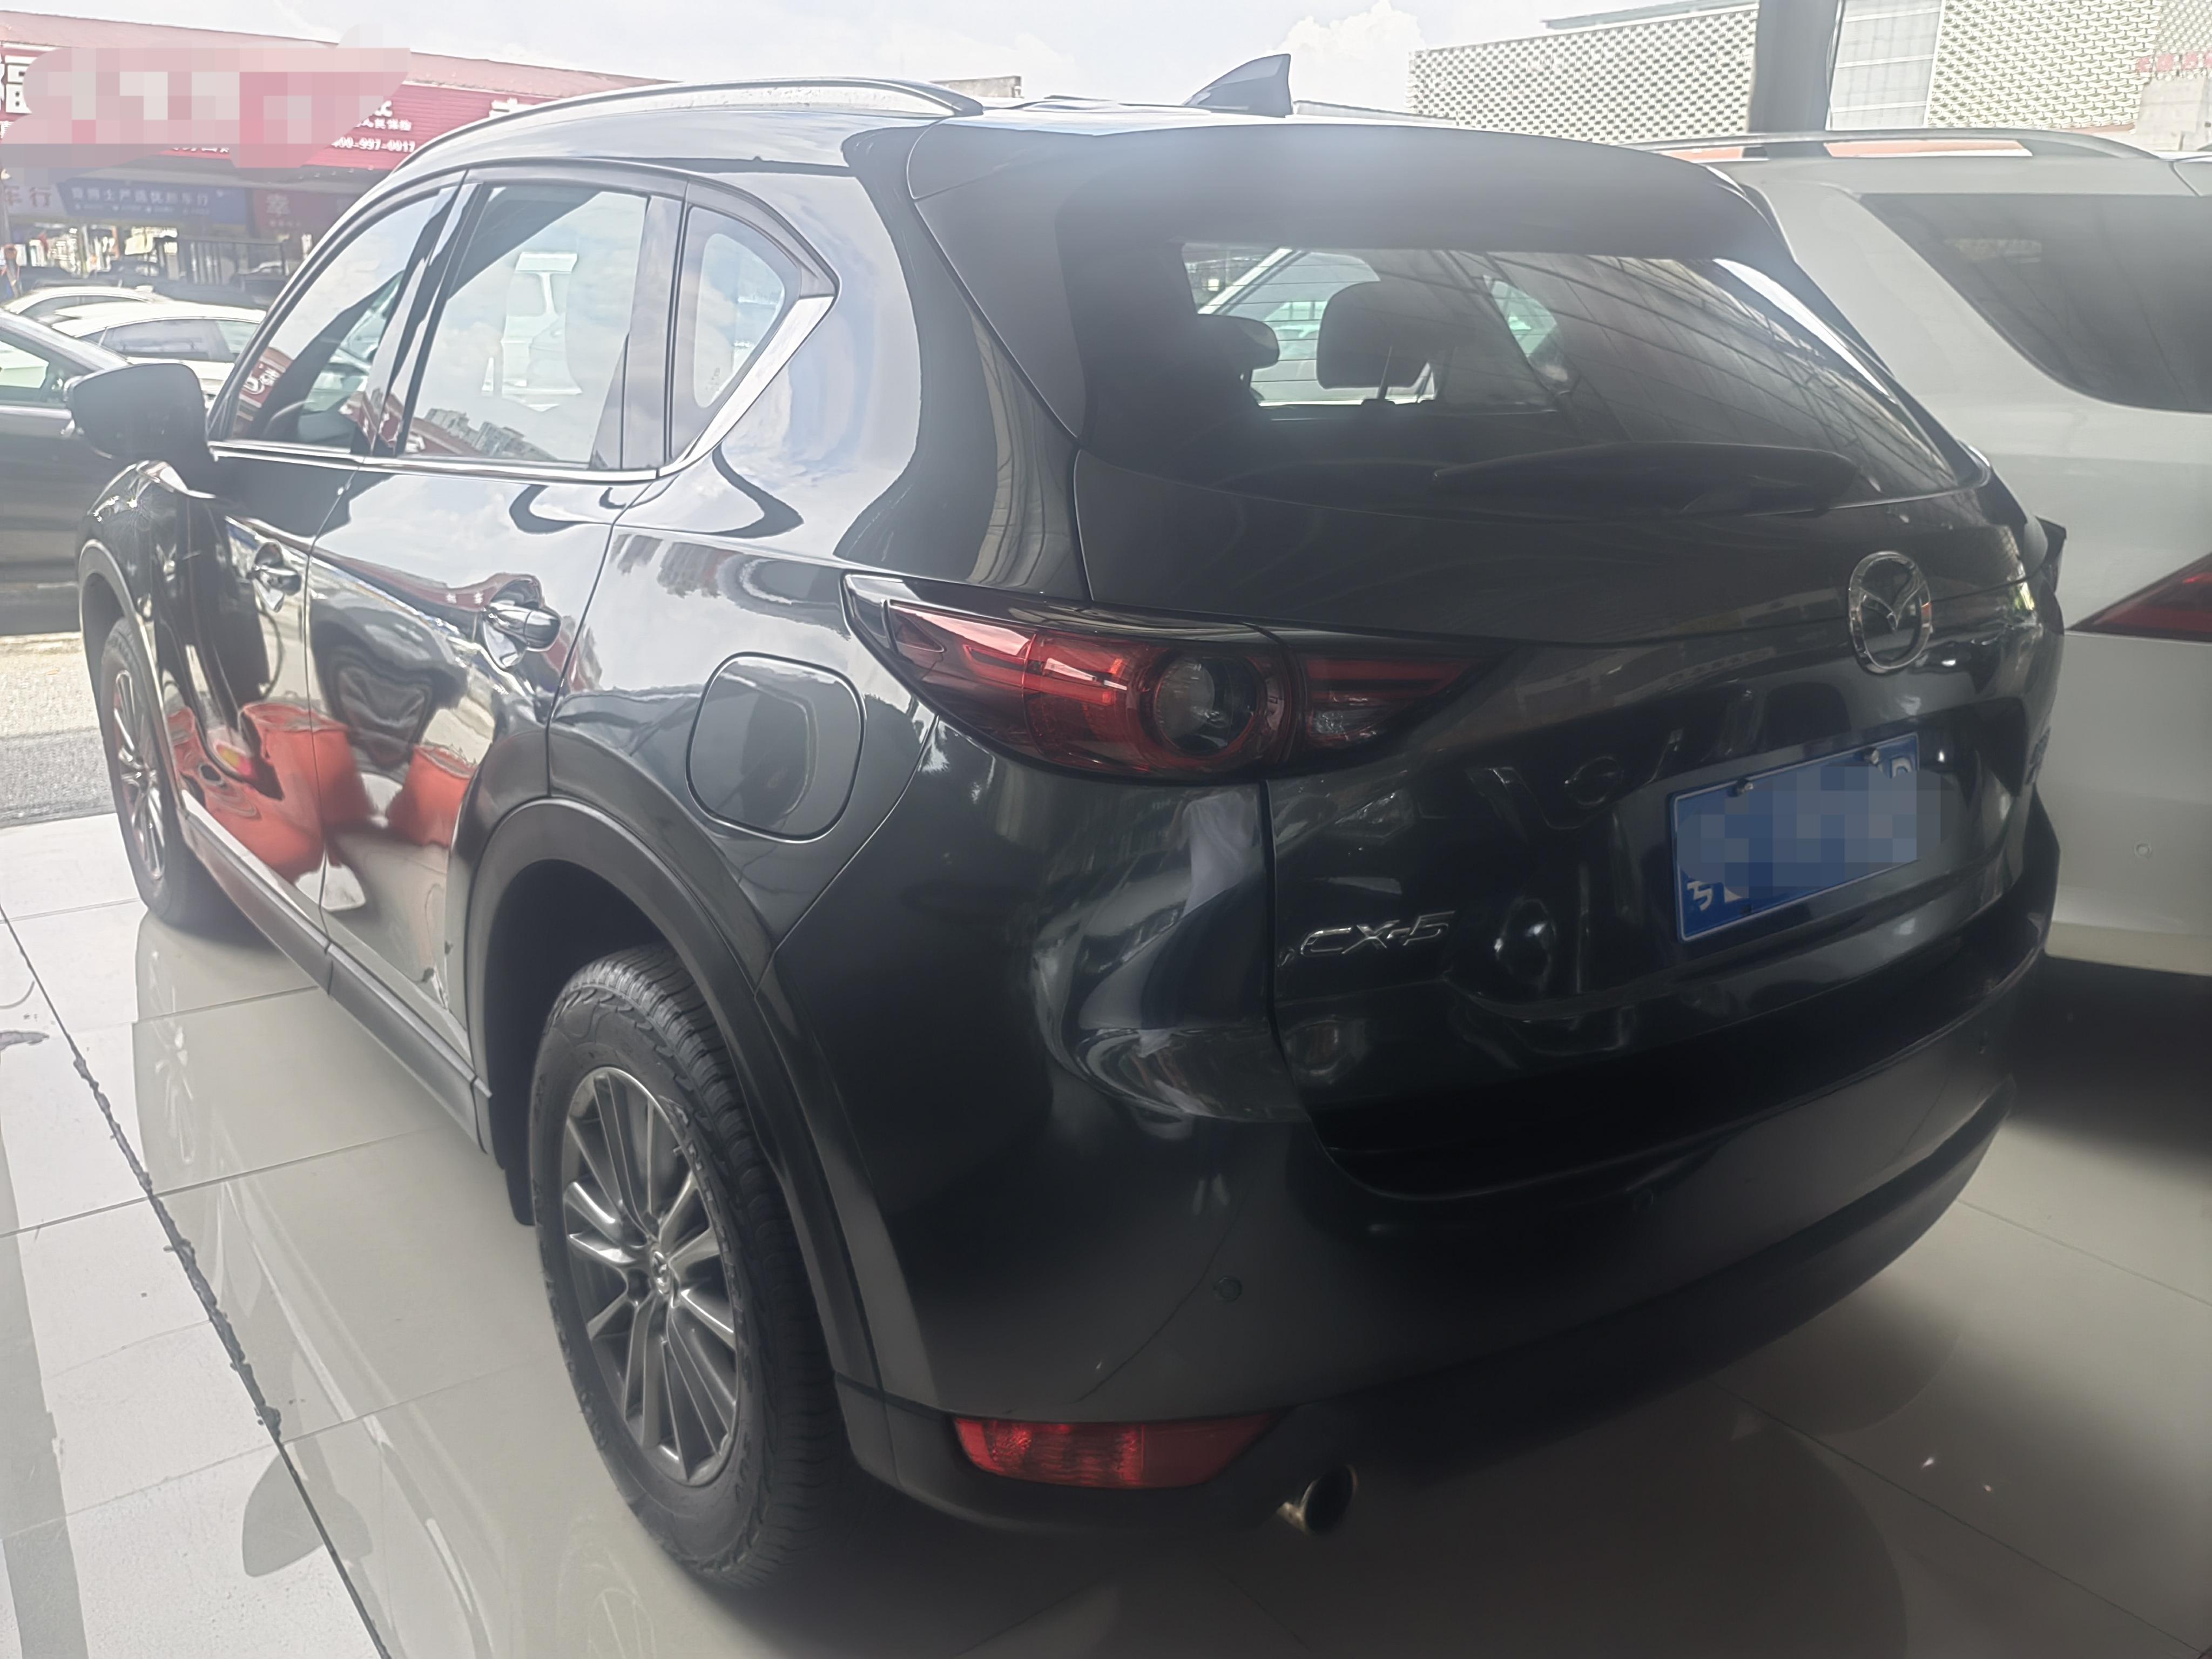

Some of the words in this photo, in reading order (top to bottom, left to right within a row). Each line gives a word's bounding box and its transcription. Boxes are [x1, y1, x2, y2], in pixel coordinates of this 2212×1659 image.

[354, 118, 413, 132] 人民保险
[1299, 911, 1456, 957] CX-5
